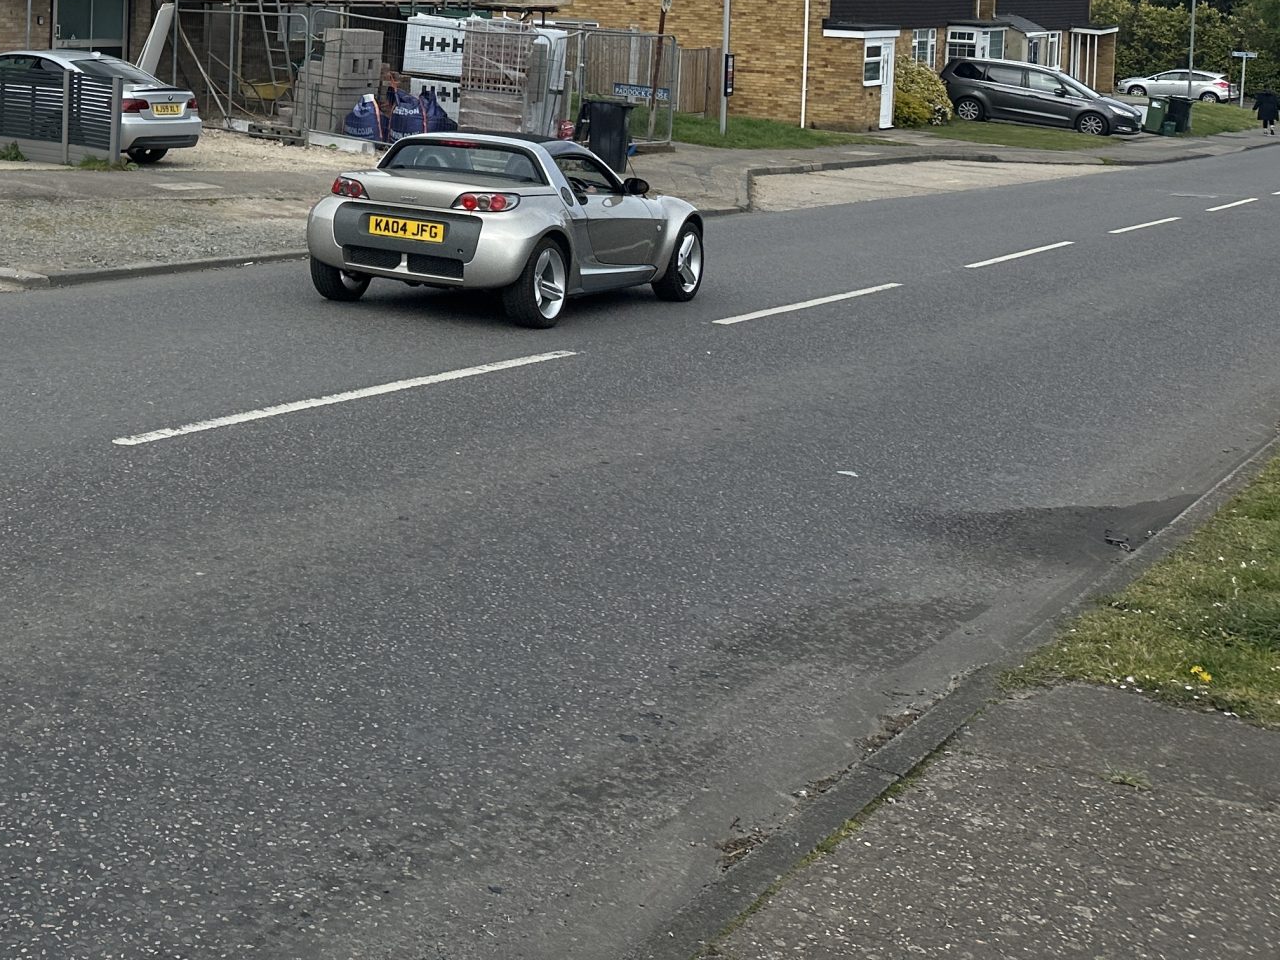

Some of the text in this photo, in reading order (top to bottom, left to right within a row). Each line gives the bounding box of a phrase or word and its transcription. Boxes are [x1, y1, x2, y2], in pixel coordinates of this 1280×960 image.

[615, 87, 646, 97] PADDOCK
[647, 91, 669, 100] COSE
[374, 218, 438, 239] KA04 JFG
